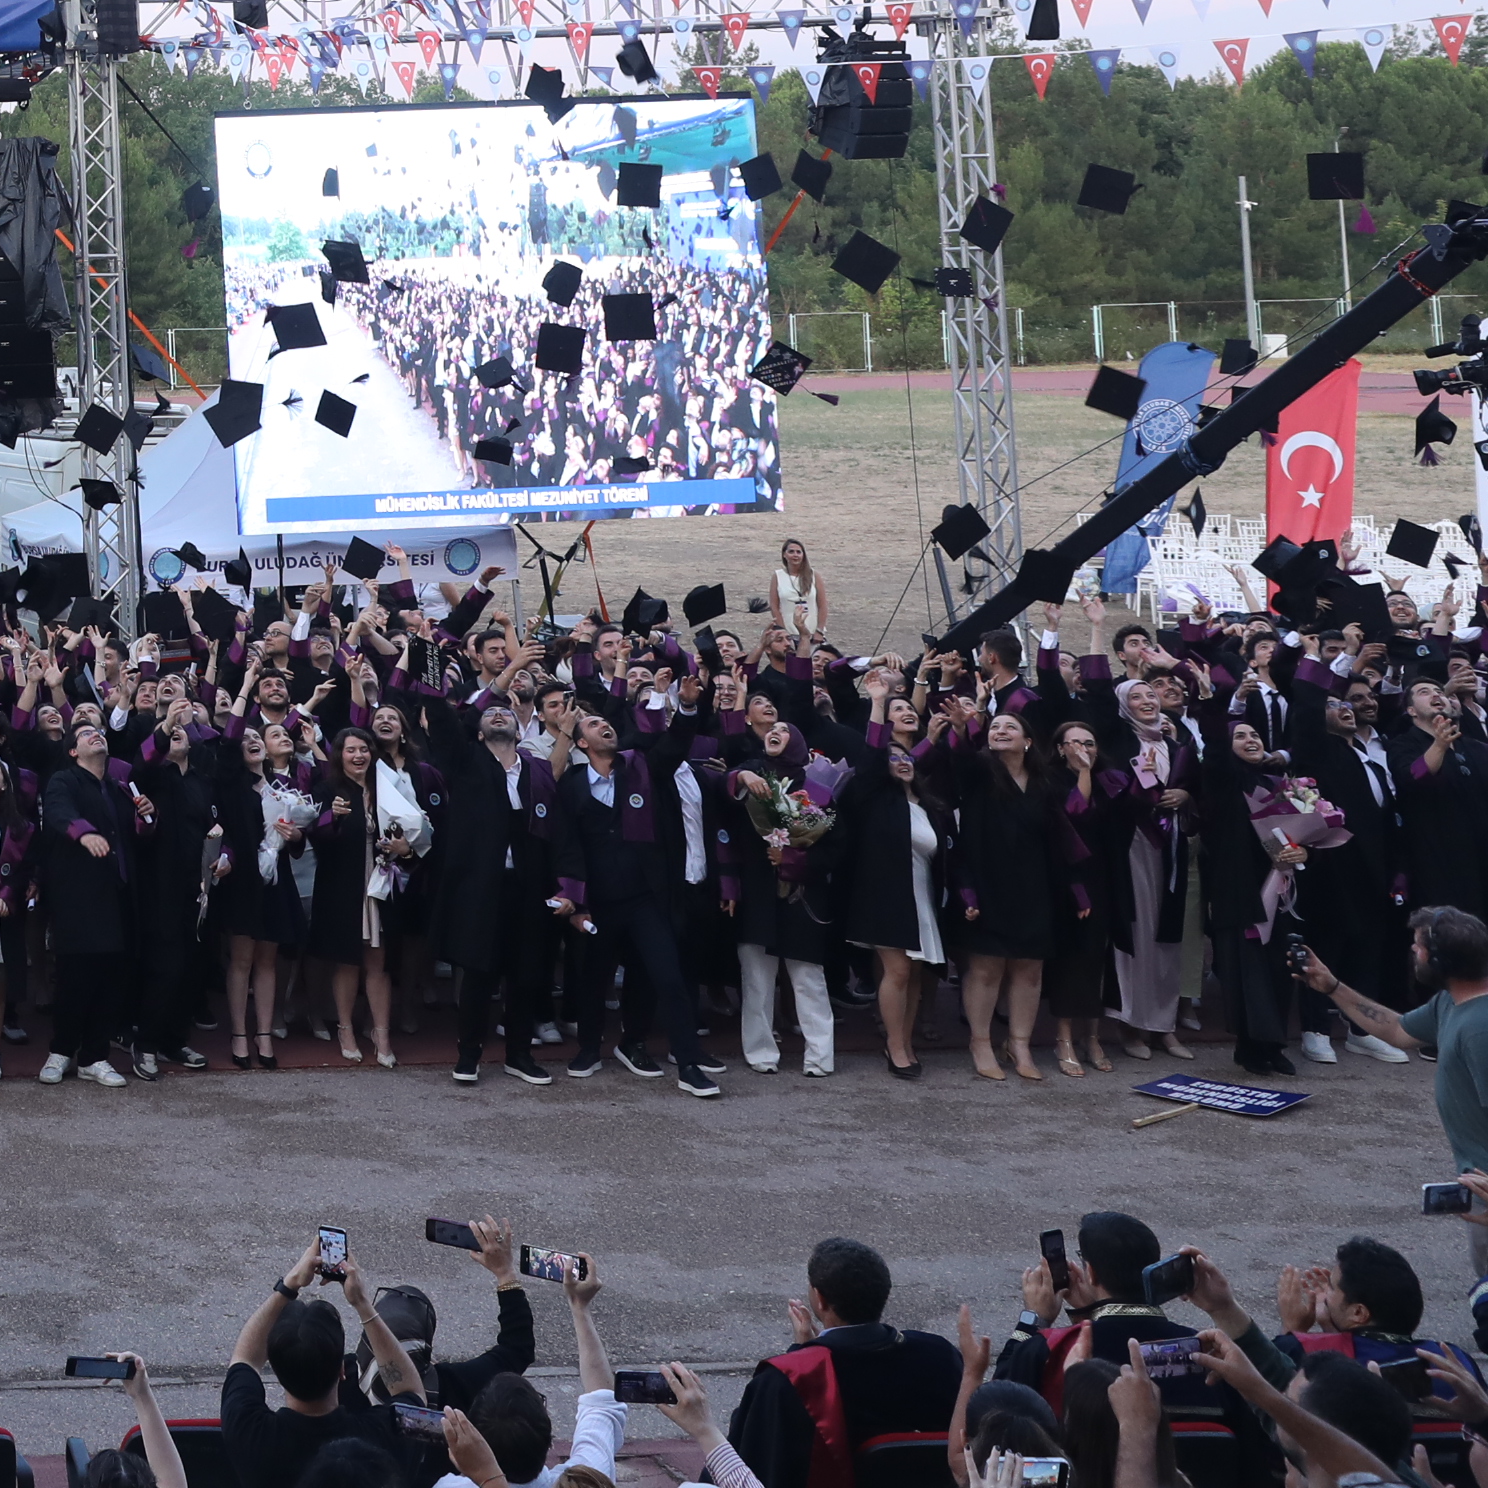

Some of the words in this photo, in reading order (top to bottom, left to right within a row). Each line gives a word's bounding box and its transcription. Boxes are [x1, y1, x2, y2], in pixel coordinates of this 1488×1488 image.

[375, 492, 460, 513] MÜHENDİSLİK
[461, 490, 528, 509] FAKÜLTESİ
[530, 486, 601, 507] MEZUNİYET
[601, 484, 649, 504] TÖRENİ
[326, 550, 435, 568] ÜNSESİ
[1189, 1081, 1281, 1100] ENDÜSTRİ
[1168, 1092, 1247, 1110] BÖLÜMÜ
